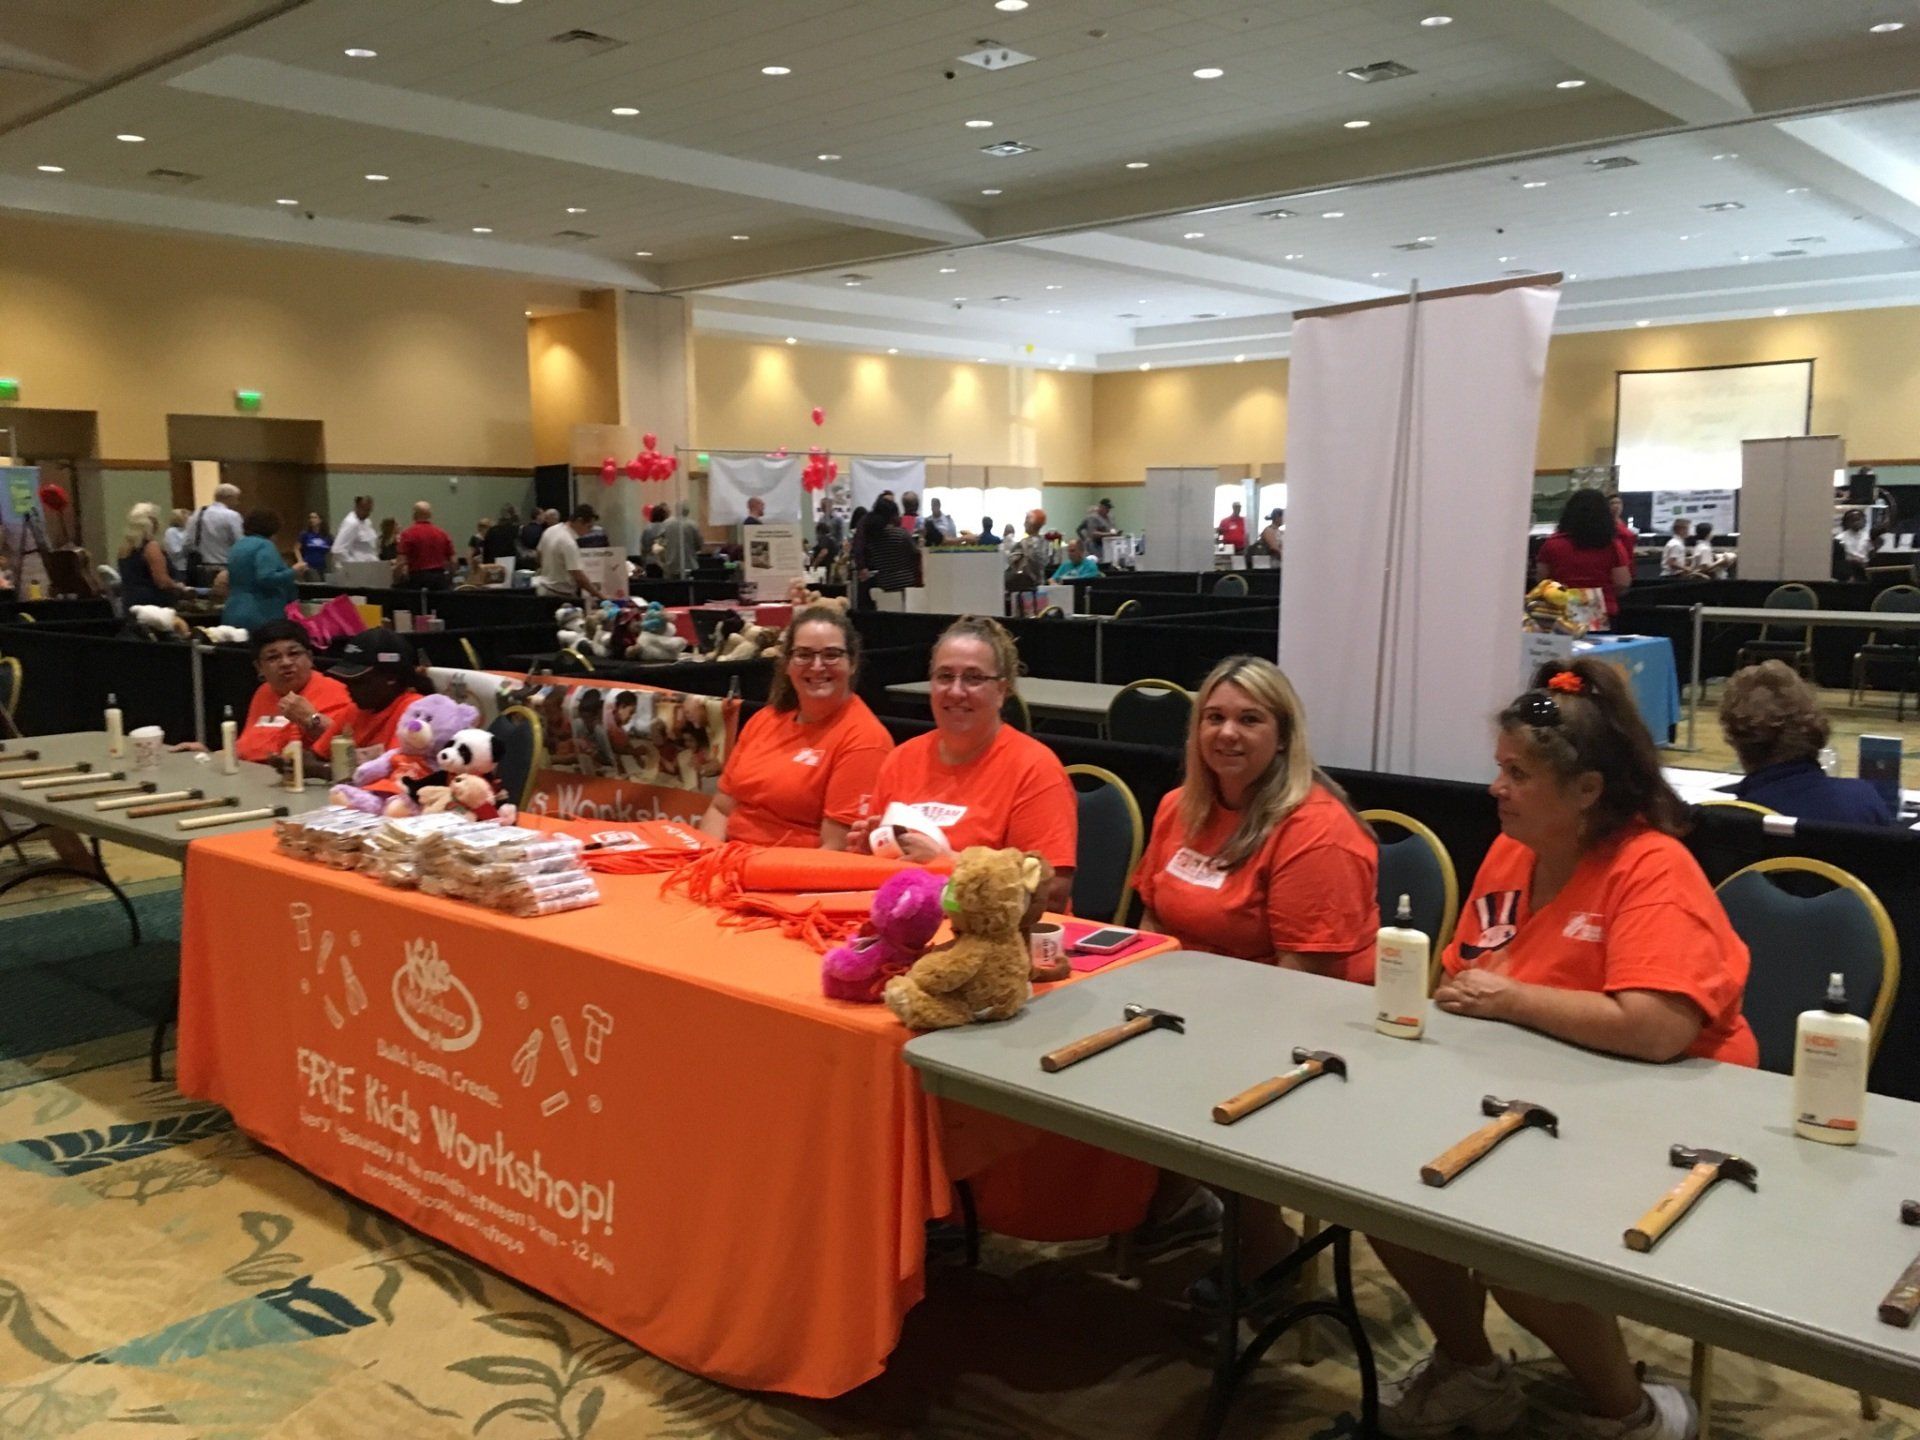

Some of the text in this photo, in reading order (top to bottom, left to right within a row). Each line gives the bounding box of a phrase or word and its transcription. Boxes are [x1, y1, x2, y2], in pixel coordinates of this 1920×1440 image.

[366, 1074, 421, 1144] Kids
[430, 1105, 615, 1236] Workshop!
[572, 1239, 589, 1262] 12
